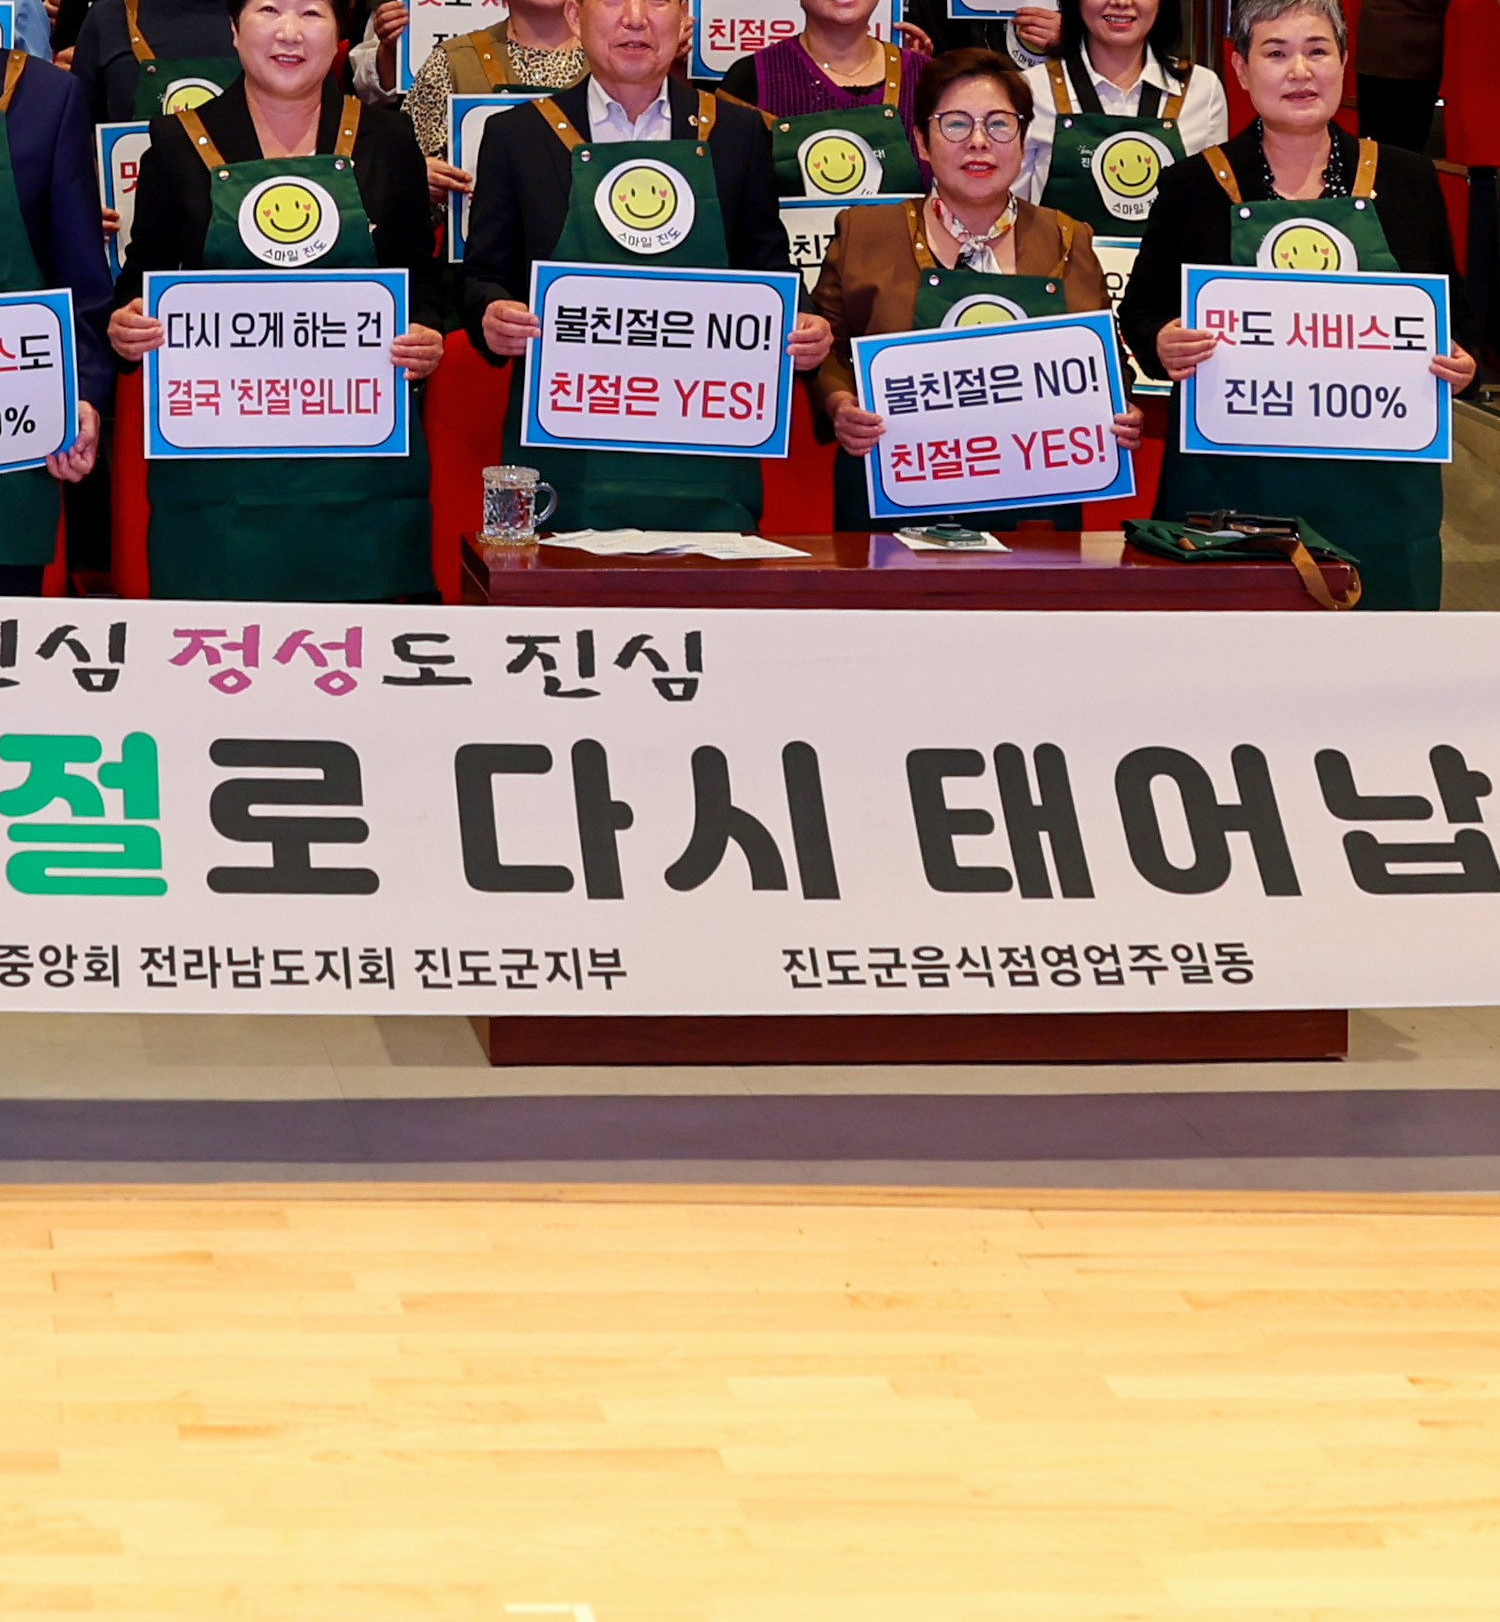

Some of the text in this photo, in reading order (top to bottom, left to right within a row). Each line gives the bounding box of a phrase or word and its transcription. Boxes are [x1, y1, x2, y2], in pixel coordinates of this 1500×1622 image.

[261, 240, 327, 262] 스마일 진도
[617, 227, 681, 248] 스마일 진도
[168, 312, 381, 348] 다시 오게 하는 건
[555, 306, 771, 350] 불친절은 NO!
[1205, 308, 1427, 351] 맛도 서비스도
[168, 378, 381, 416] 결국 '친절'입니다
[550, 372, 765, 420] 친절은 YES!
[885, 356, 1098, 415] 불친절은 NO!
[1225, 379, 1407, 418] 진심 100%
[891, 425, 1105, 482] 친절은 YES!
[168, 625, 472, 696] 정성도
[506, 630, 703, 701] 진심
[455, 738, 840, 900] 다시
[140, 946, 395, 990] 전라남도지회
[415, 947, 627, 990] 진도군지부
[782, 942, 1254, 988] 진도군음식점영업주일동
